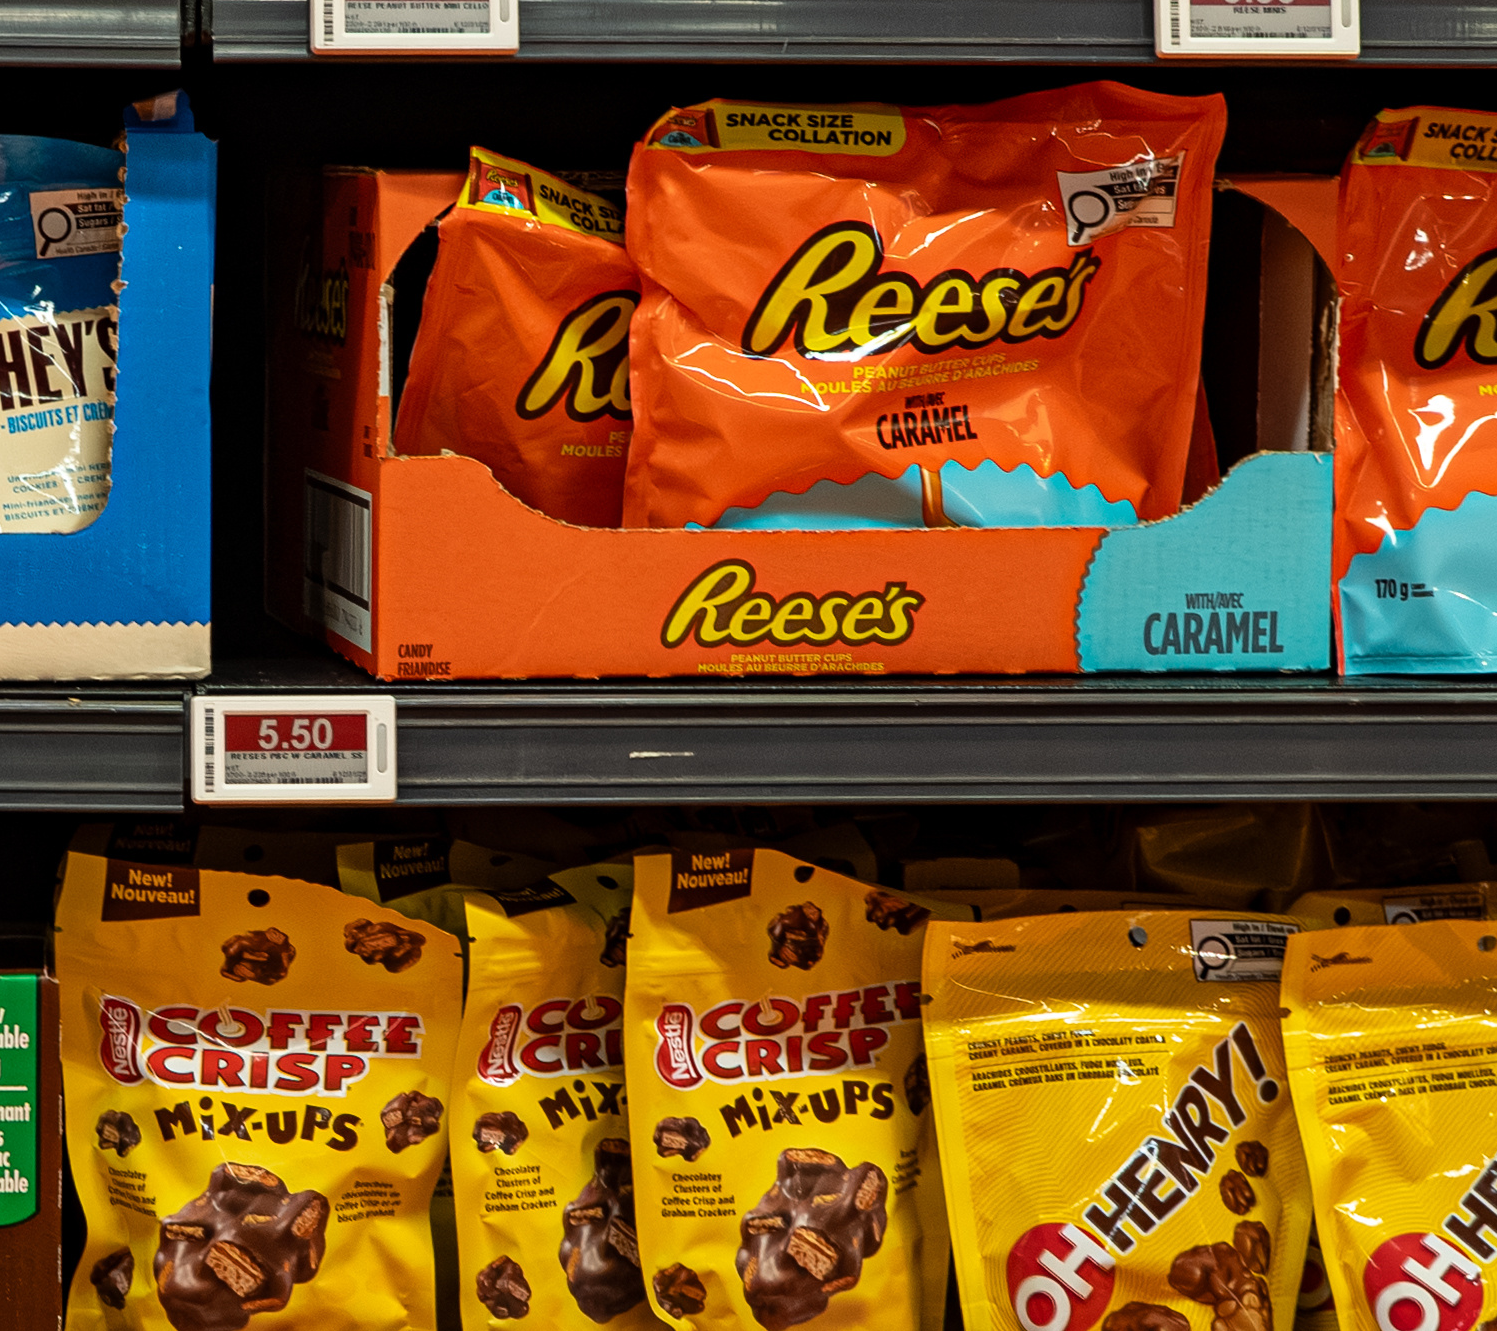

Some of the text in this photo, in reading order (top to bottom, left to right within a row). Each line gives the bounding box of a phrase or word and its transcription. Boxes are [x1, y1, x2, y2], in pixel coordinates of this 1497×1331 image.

[665, 562, 918, 647] Reese's
[1143, 611, 1284, 654] CARAMEL
[257, 719, 333, 750] 5.50
[112, 886, 194, 905] Nouveau!
[129, 871, 172, 887] New!
[148, 1007, 423, 1054] COFFEE
[146, 1048, 366, 1091] CRISP
[1085, 1023, 1281, 1253] HENRY!
